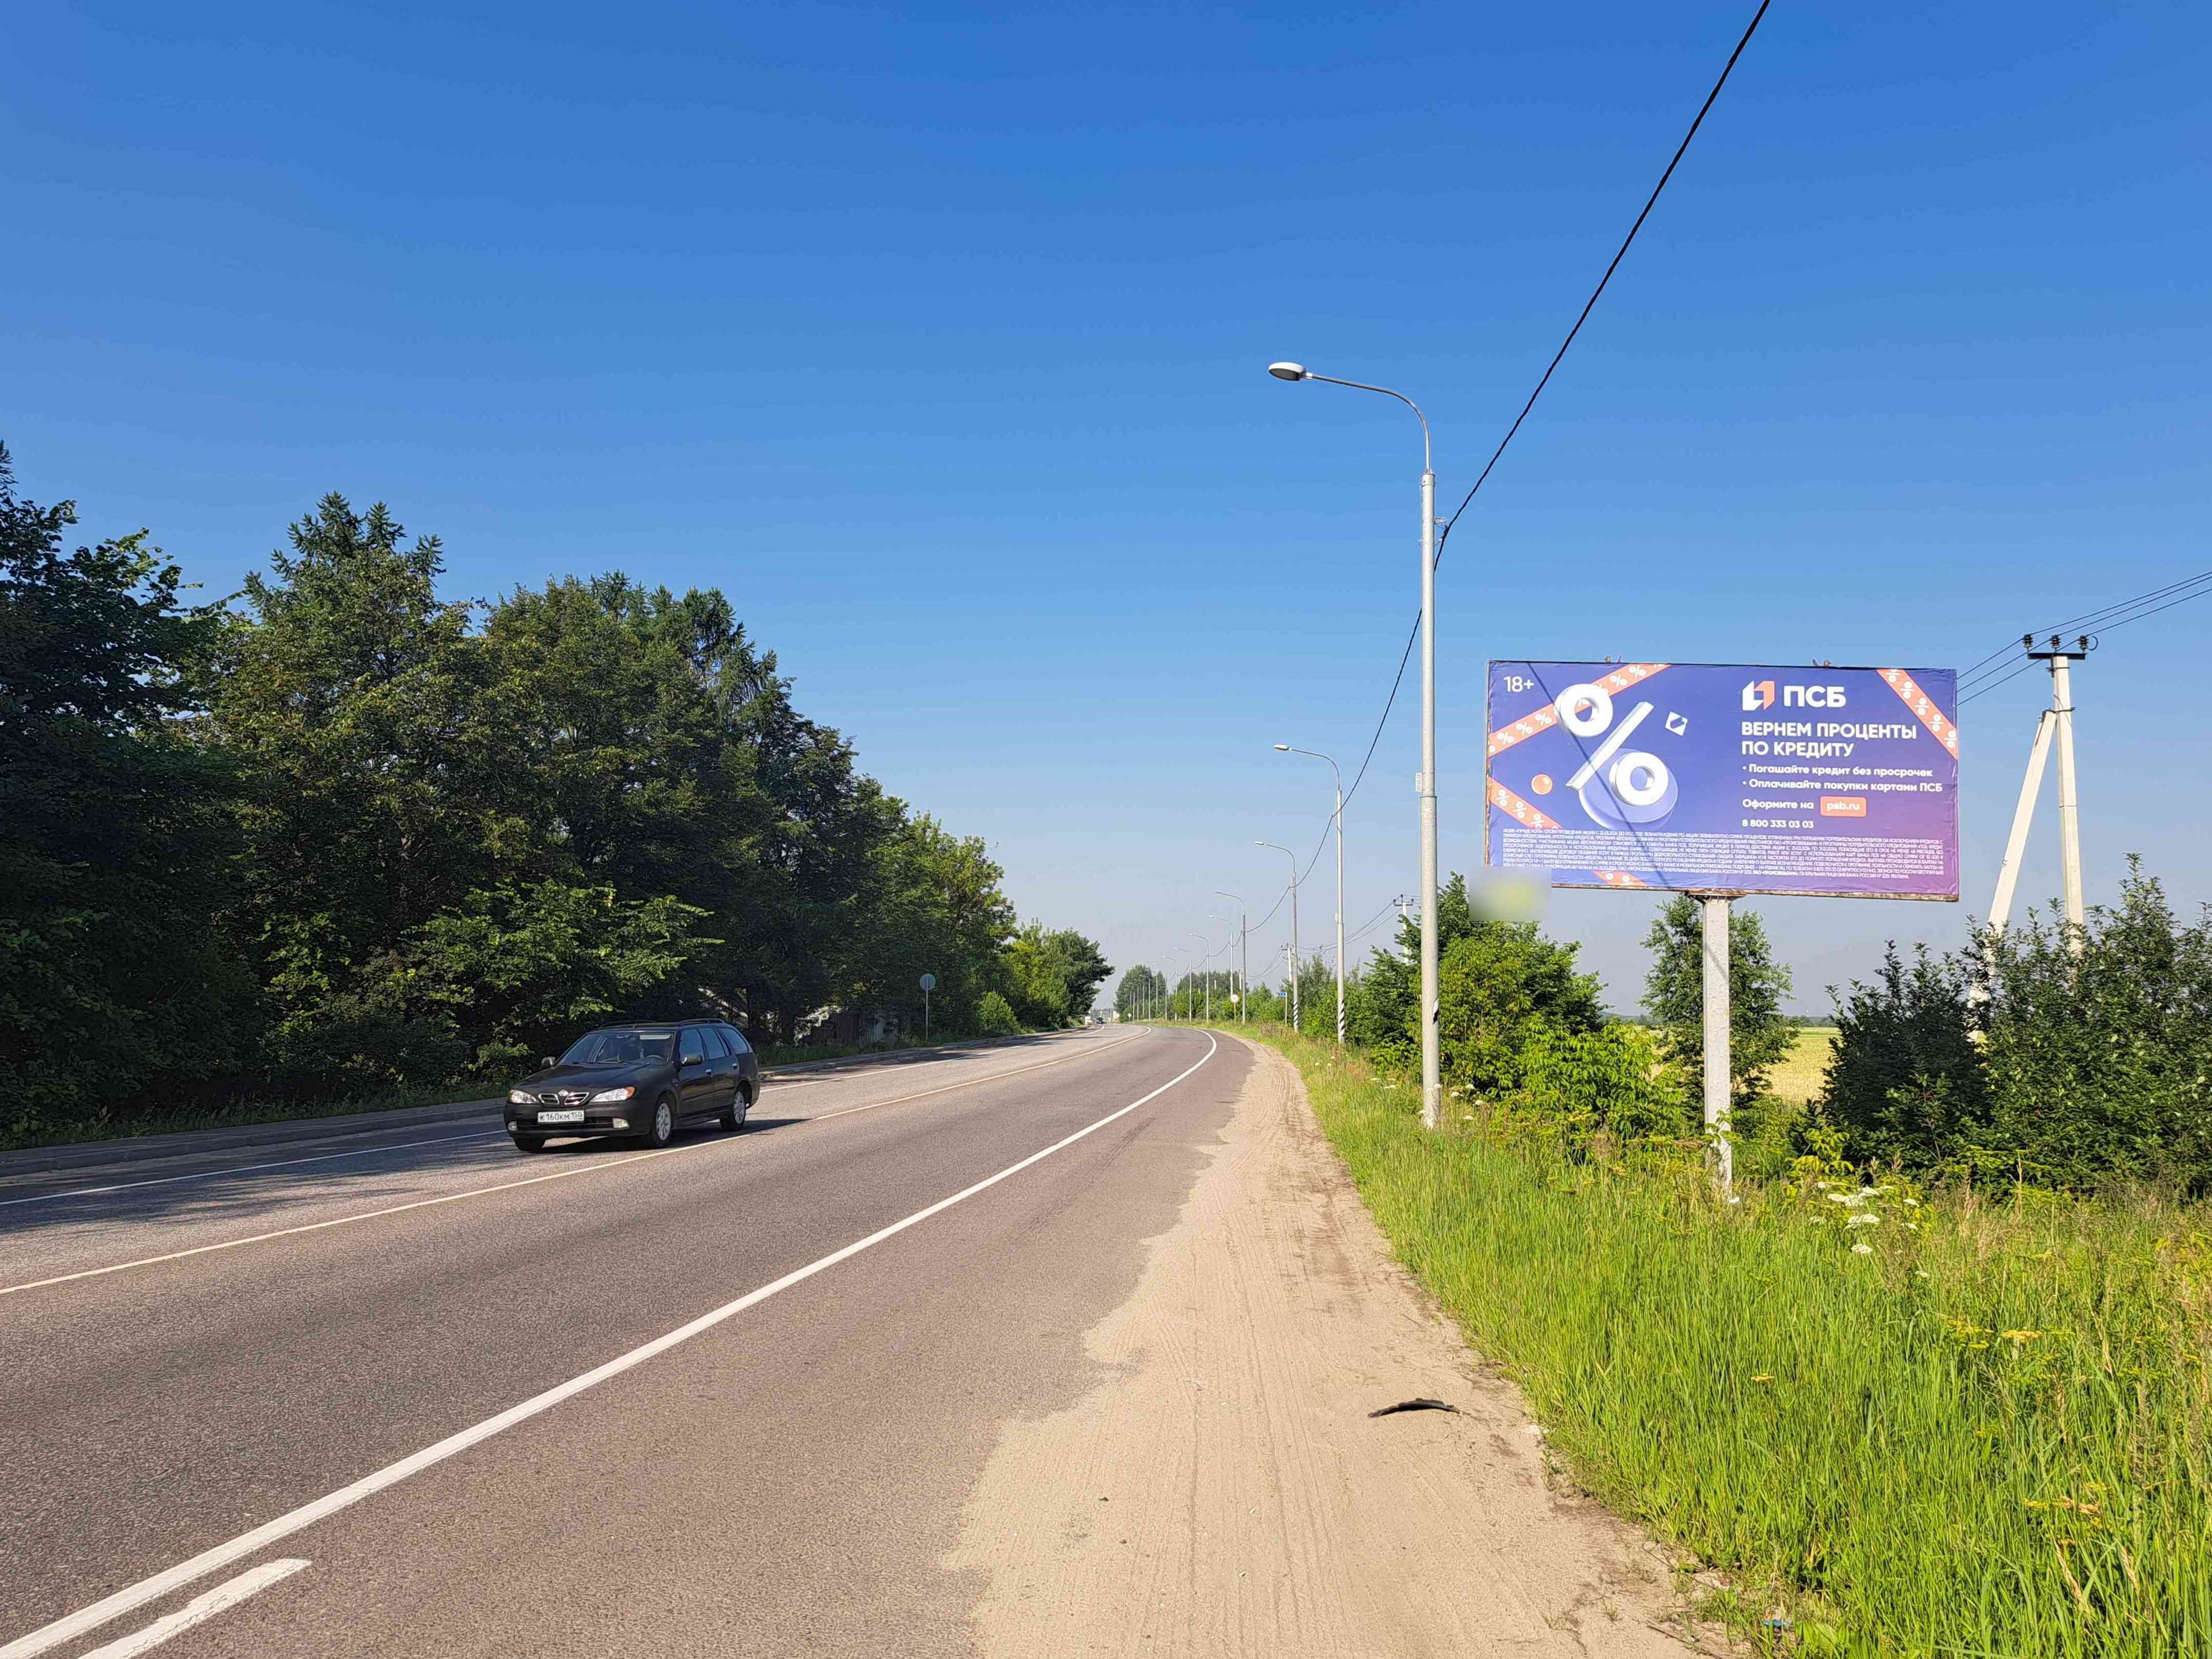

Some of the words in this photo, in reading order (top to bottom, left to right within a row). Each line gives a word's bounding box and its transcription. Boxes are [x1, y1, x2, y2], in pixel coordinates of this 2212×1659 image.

[1503, 676, 1534, 692] 18+
[1784, 686, 1846, 708] ПСБ
[1742, 722, 1811, 736] ВЕРНЕМ
[1817, 723, 1917, 740] ПРОЦЕНТЫ
[1742, 741, 1769, 755] ПО
[1774, 742, 1855, 758] КРЕДИТУ
[1749, 764, 1809, 774] Погашайте
[1812, 767, 1851, 776] кредит
[1852, 767, 1871, 775] без
[1874, 769, 1933, 777] просрочек
[1749, 779, 1821, 789] Оплачивайте
[1824, 782, 1868, 792] покупки
[1870, 783, 1917, 793] картами
[1920, 783, 1943, 792] ПСБ
[1742, 799, 1798, 810] Оформите
[1826, 801, 1860, 811] psb.ru
